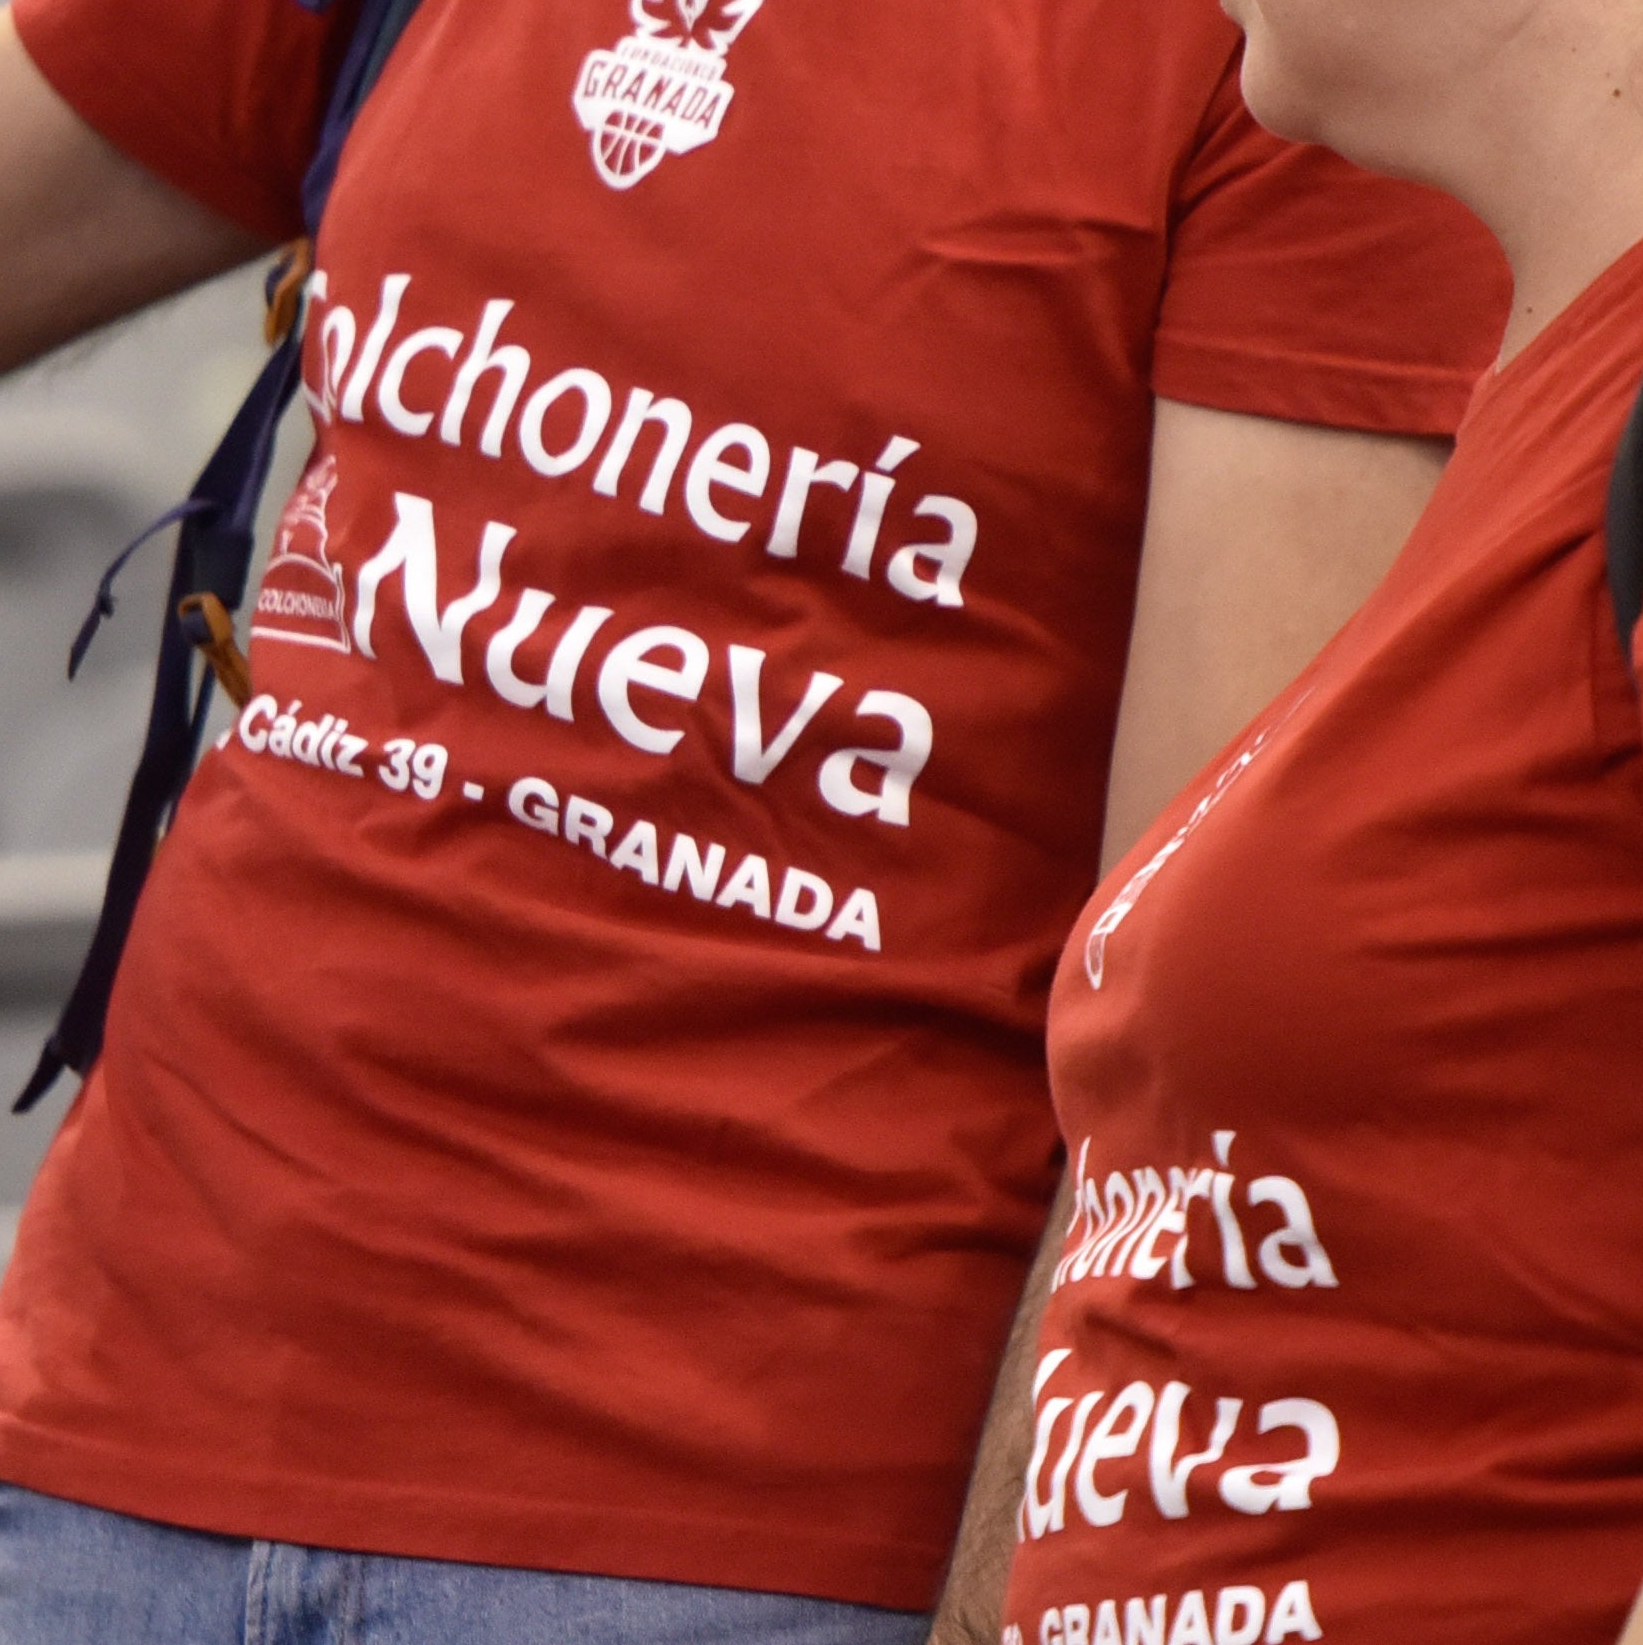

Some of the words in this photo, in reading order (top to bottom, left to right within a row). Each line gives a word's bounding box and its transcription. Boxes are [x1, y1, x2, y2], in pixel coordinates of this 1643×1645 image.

[582, 59, 722, 130] GRANADA
[354, 491, 934, 827] Nueva
[239, 693, 369, 777] Cádiz
[378, 738, 448, 800] 39
[507, 777, 882, 951] GRANADA
